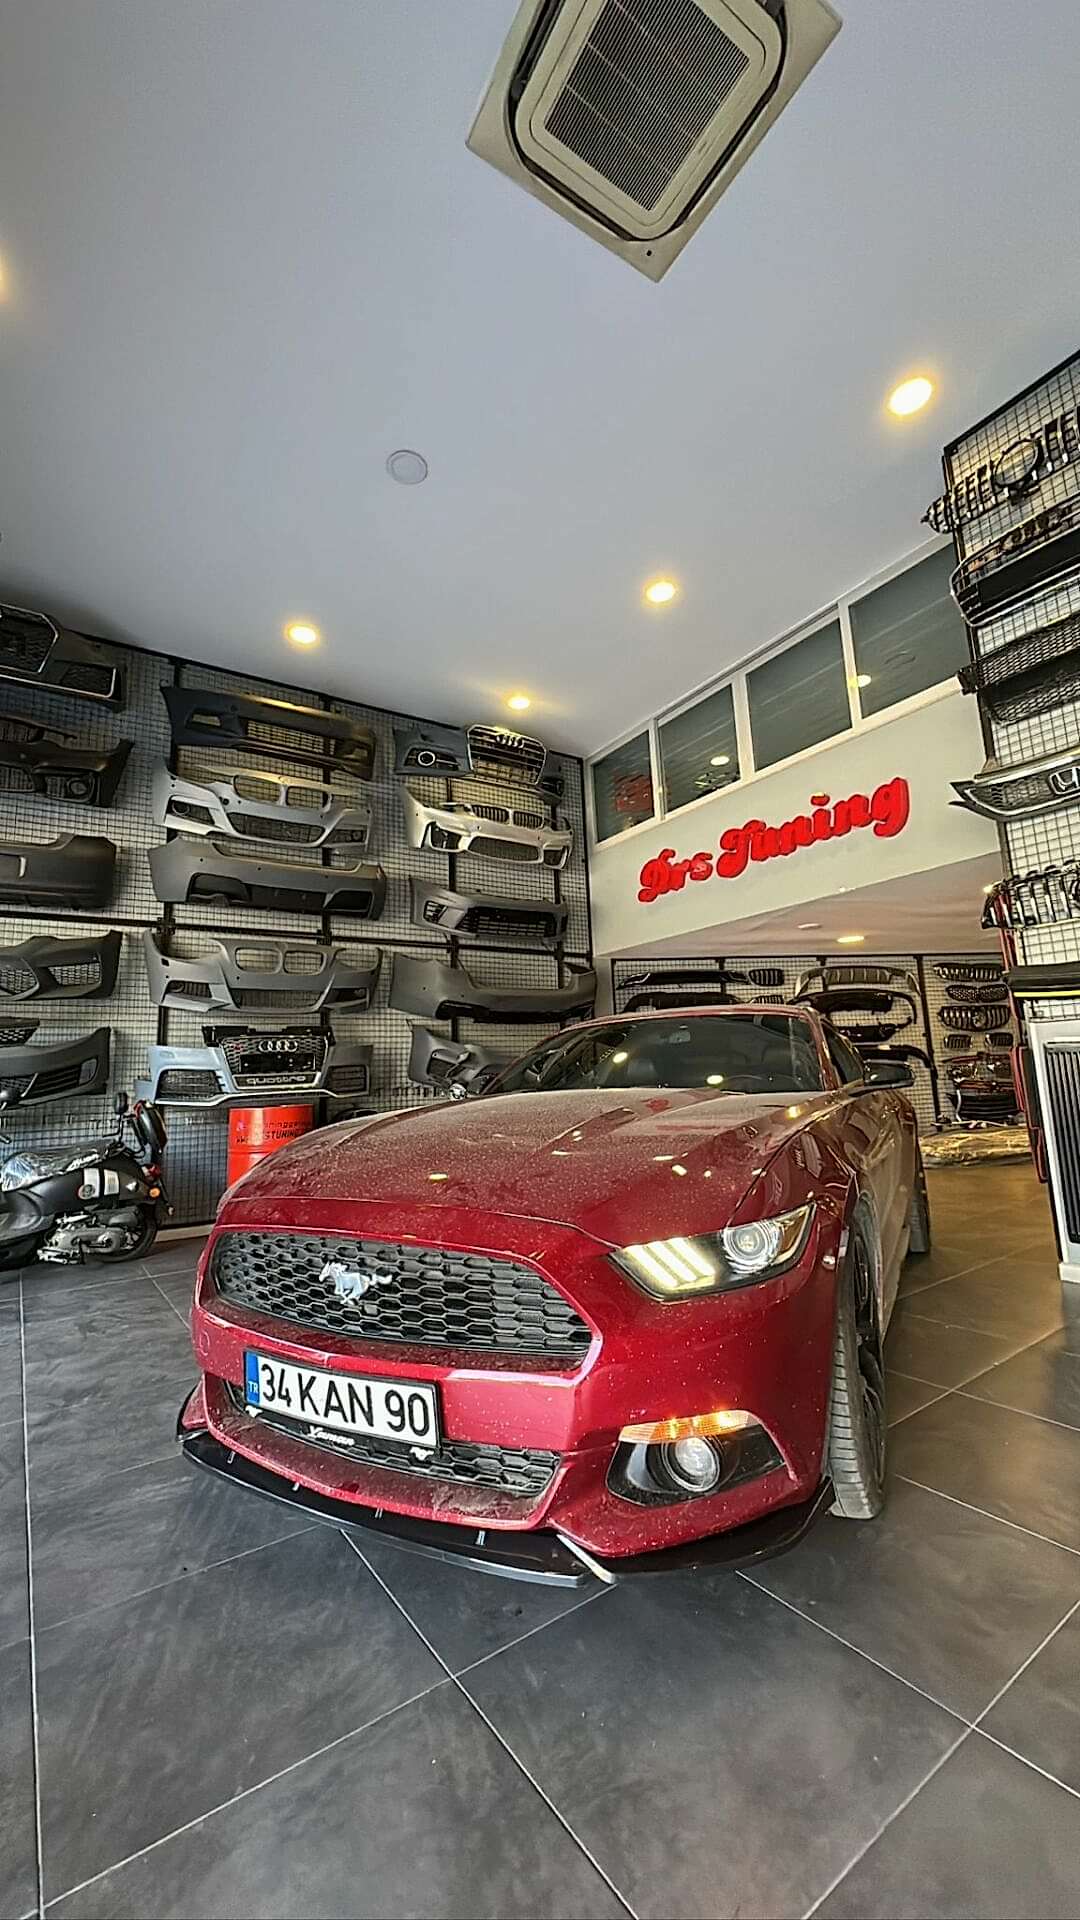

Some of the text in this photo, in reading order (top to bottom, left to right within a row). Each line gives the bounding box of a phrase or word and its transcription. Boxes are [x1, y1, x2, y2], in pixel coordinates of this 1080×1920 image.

[638, 776, 910, 903] Drs Tuning
[246, 1075, 306, 1086] quattro
[248, 1381, 259, 1394] TR
[260, 1363, 431, 1437] 34 KAN 90
